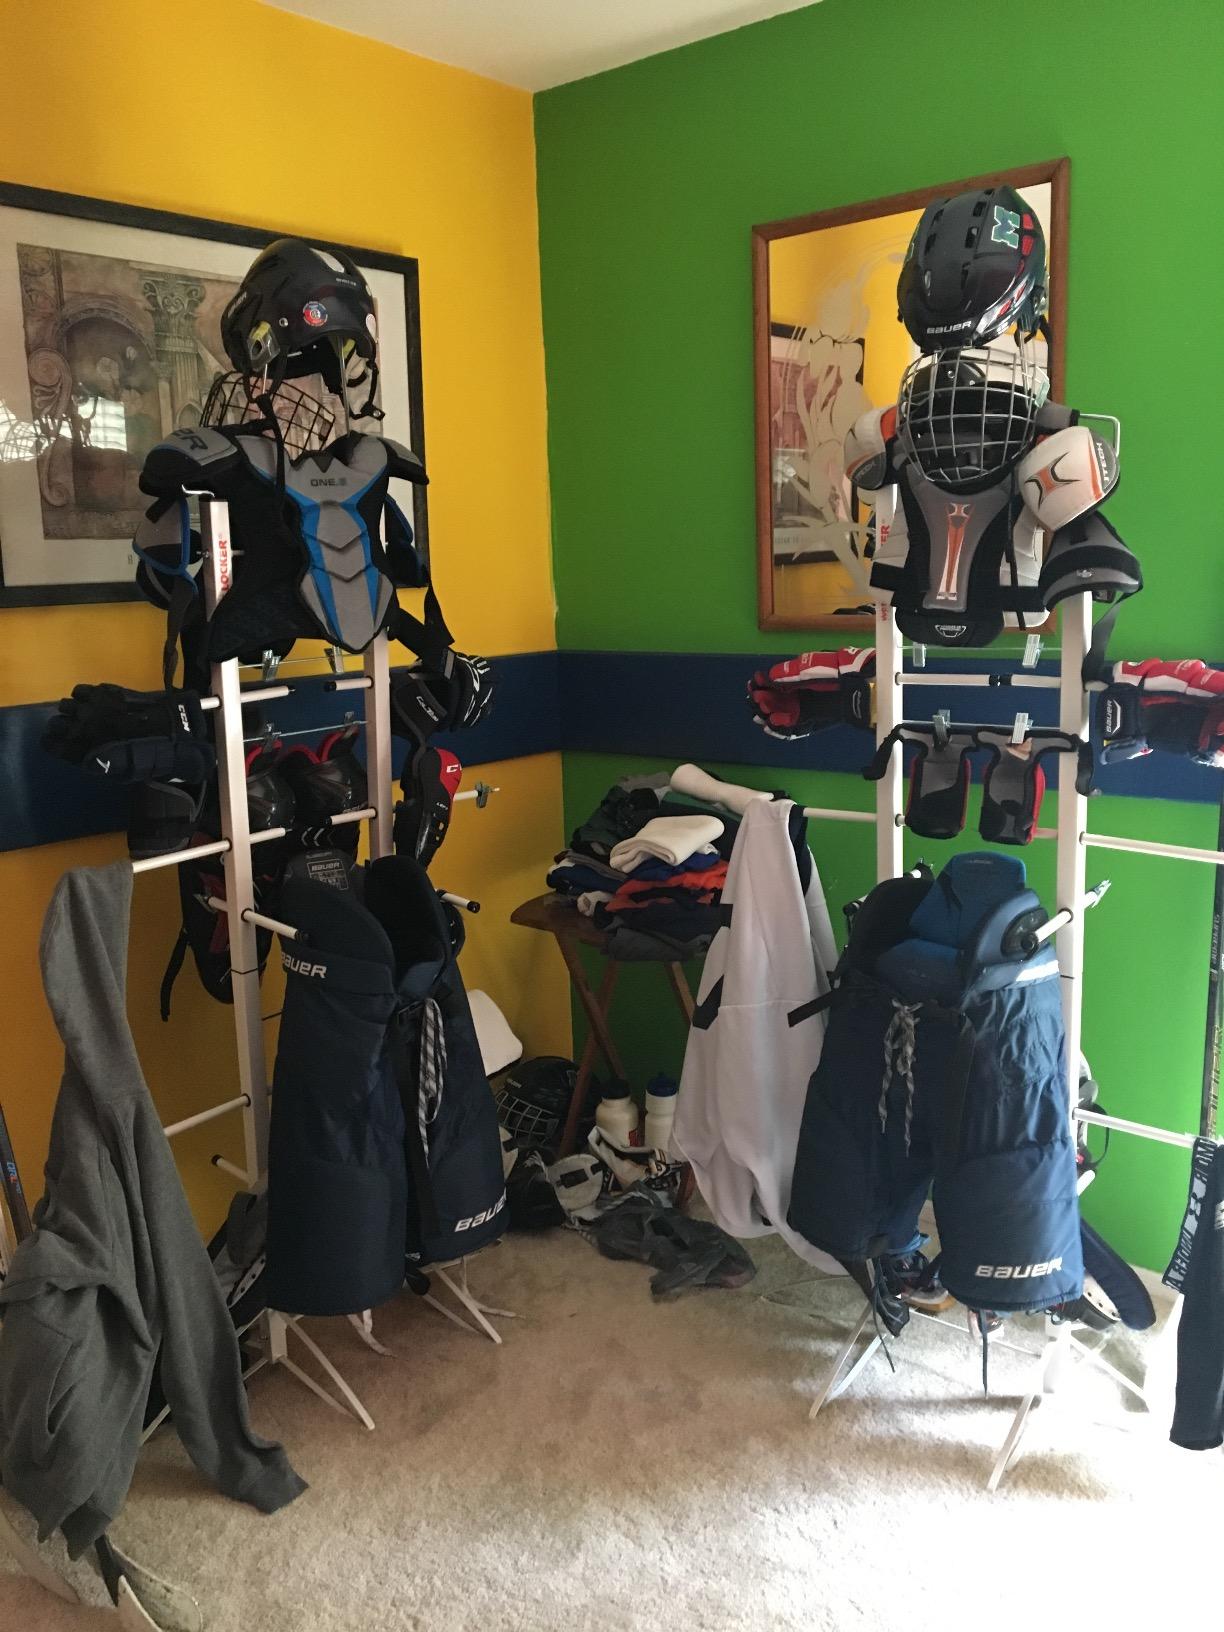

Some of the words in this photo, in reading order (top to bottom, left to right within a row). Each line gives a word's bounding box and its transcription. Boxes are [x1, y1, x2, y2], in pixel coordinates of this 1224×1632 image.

[926, 320, 971, 334] BAUER
[218, 540, 230, 592] LOCKER
[975, 1256, 1063, 1279] BAUER
